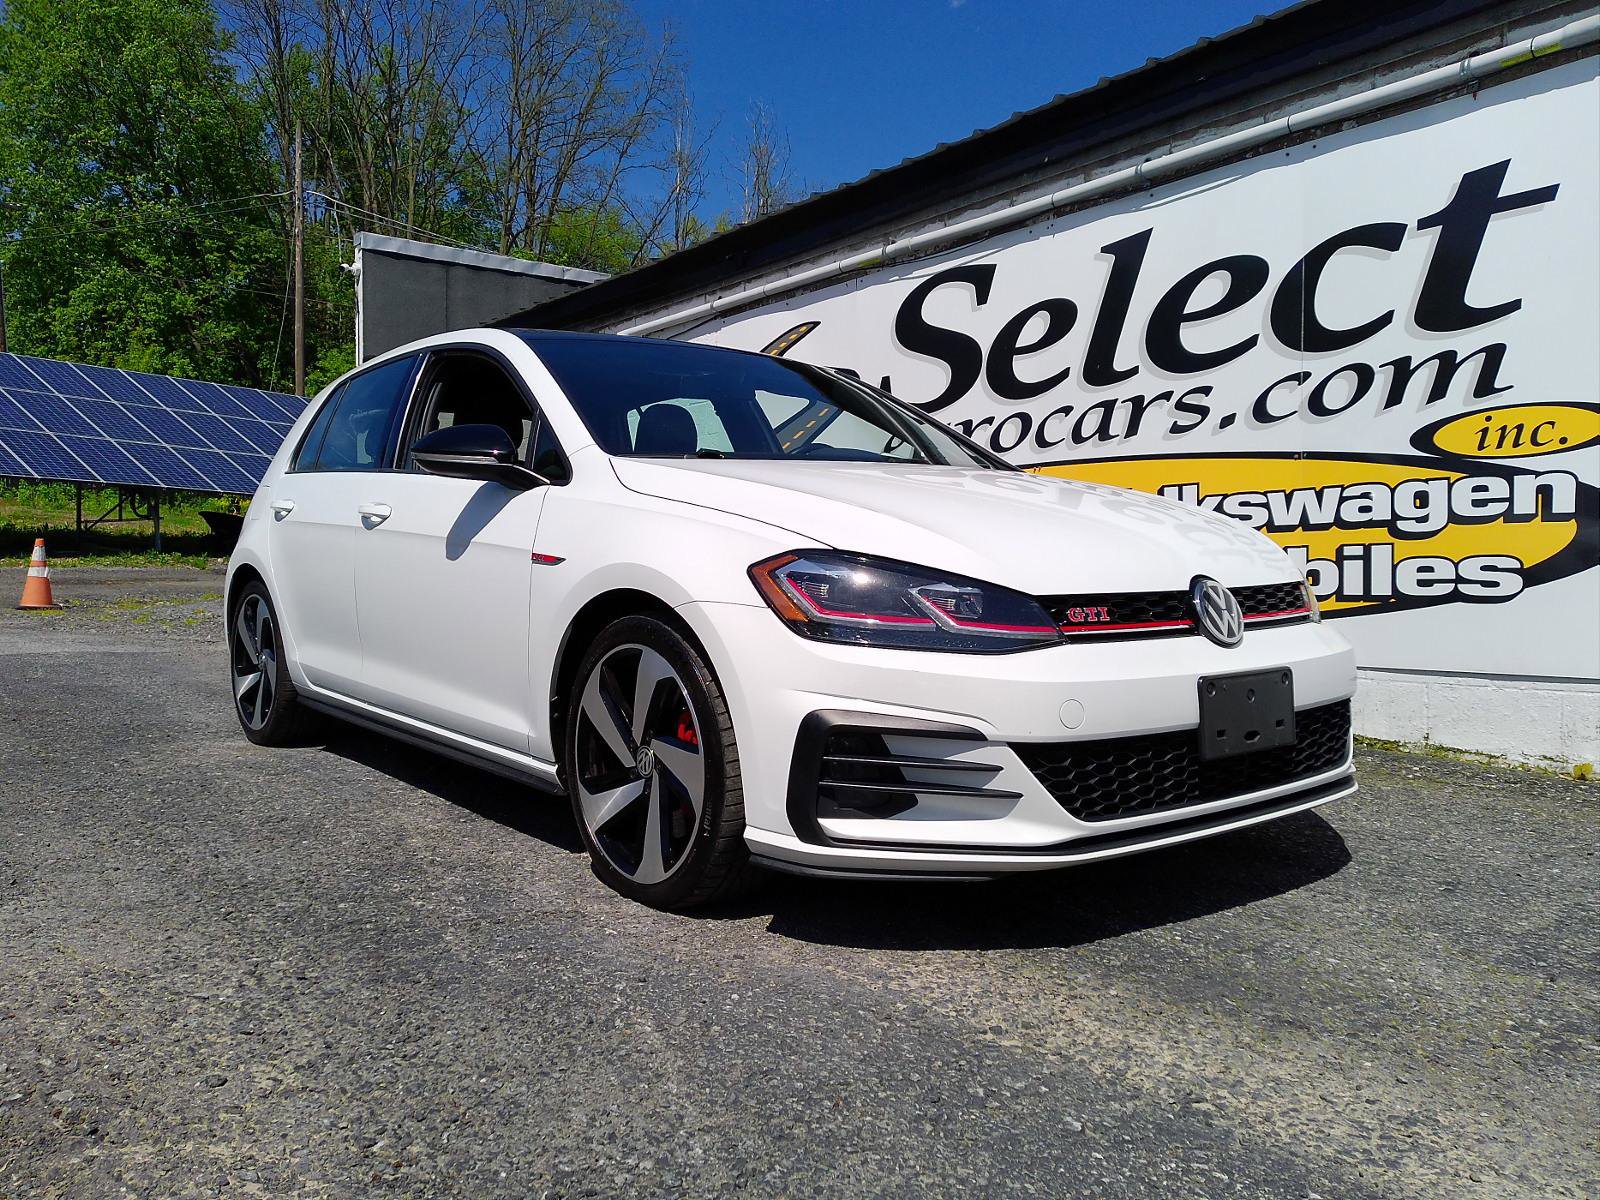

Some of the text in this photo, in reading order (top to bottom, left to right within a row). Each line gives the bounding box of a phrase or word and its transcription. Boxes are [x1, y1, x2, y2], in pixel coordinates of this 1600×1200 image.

[880, 158, 1561, 413] Select
[951, 342, 1514, 455] rocars.com
[1474, 414, 1570, 453] inc.
[1067, 607, 1111, 623] GTI
